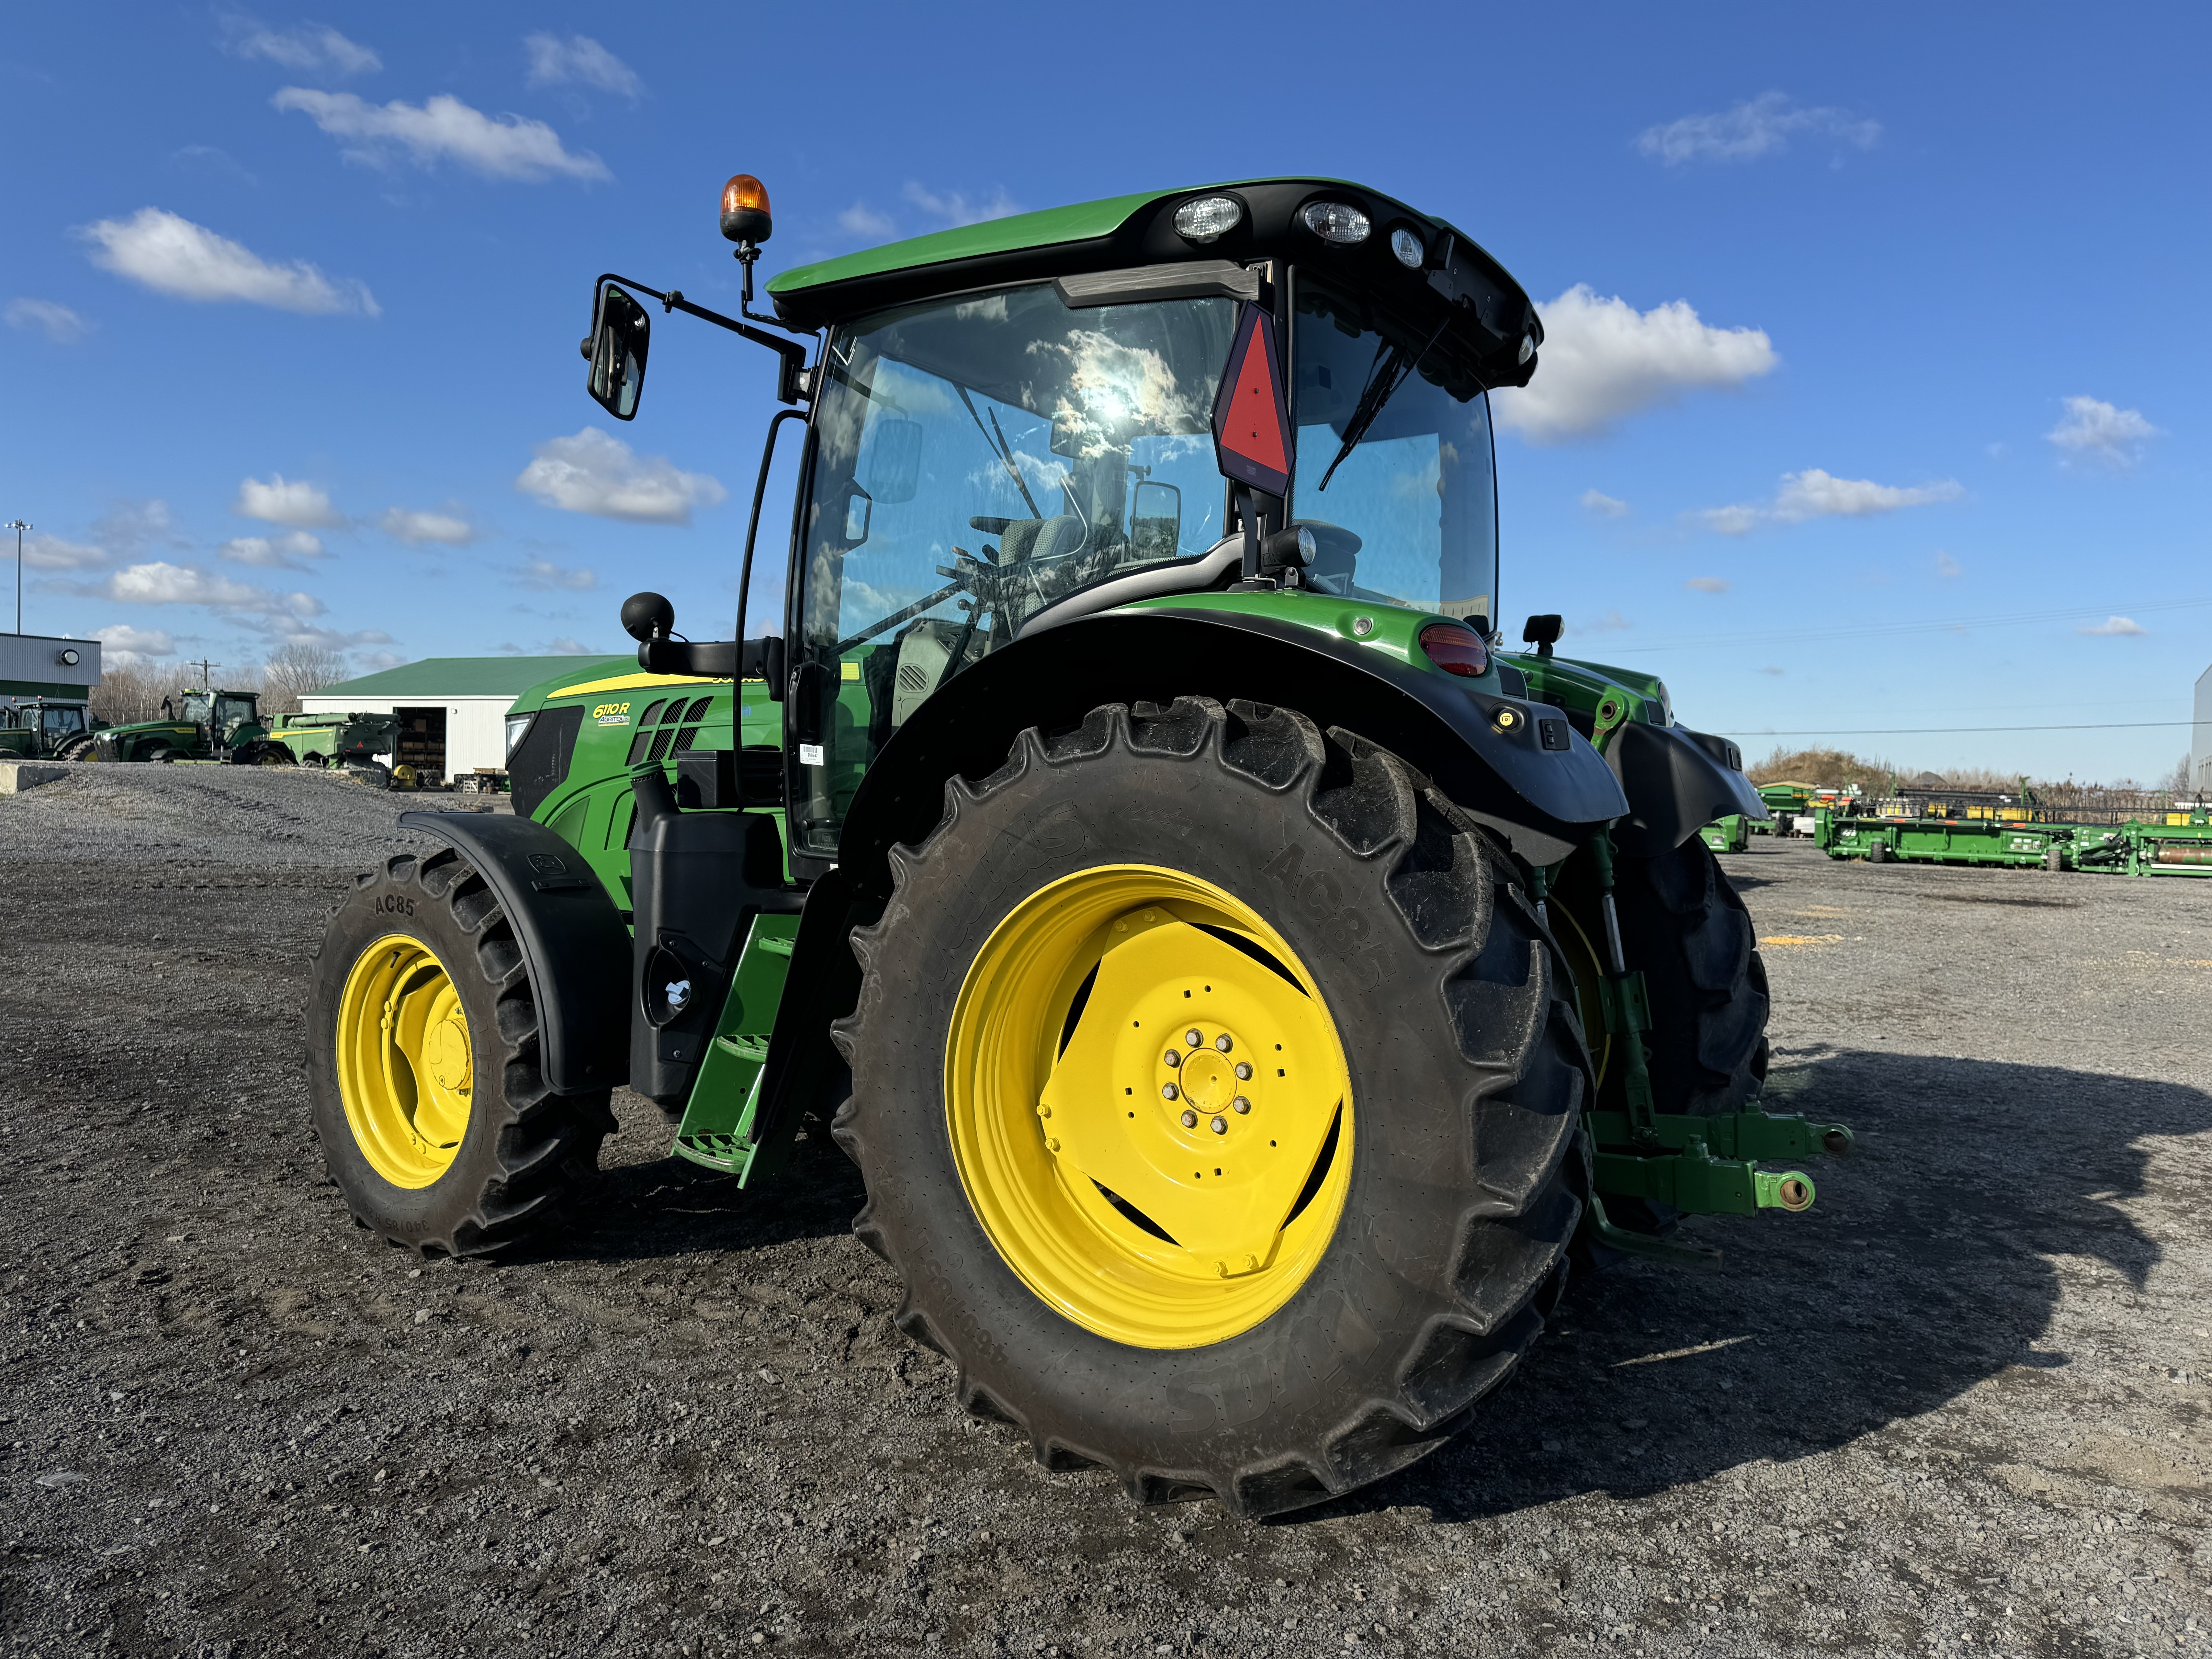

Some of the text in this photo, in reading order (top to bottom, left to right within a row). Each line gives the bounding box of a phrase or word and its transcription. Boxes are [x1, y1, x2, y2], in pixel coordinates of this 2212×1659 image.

[376, 894, 415, 916] AC85
[1262, 841, 1397, 991] AC85
[375, 1212, 381, 1224] R
[385, 1218, 430, 1233] 340/85
[925, 1257, 1009, 1367] 460/85
